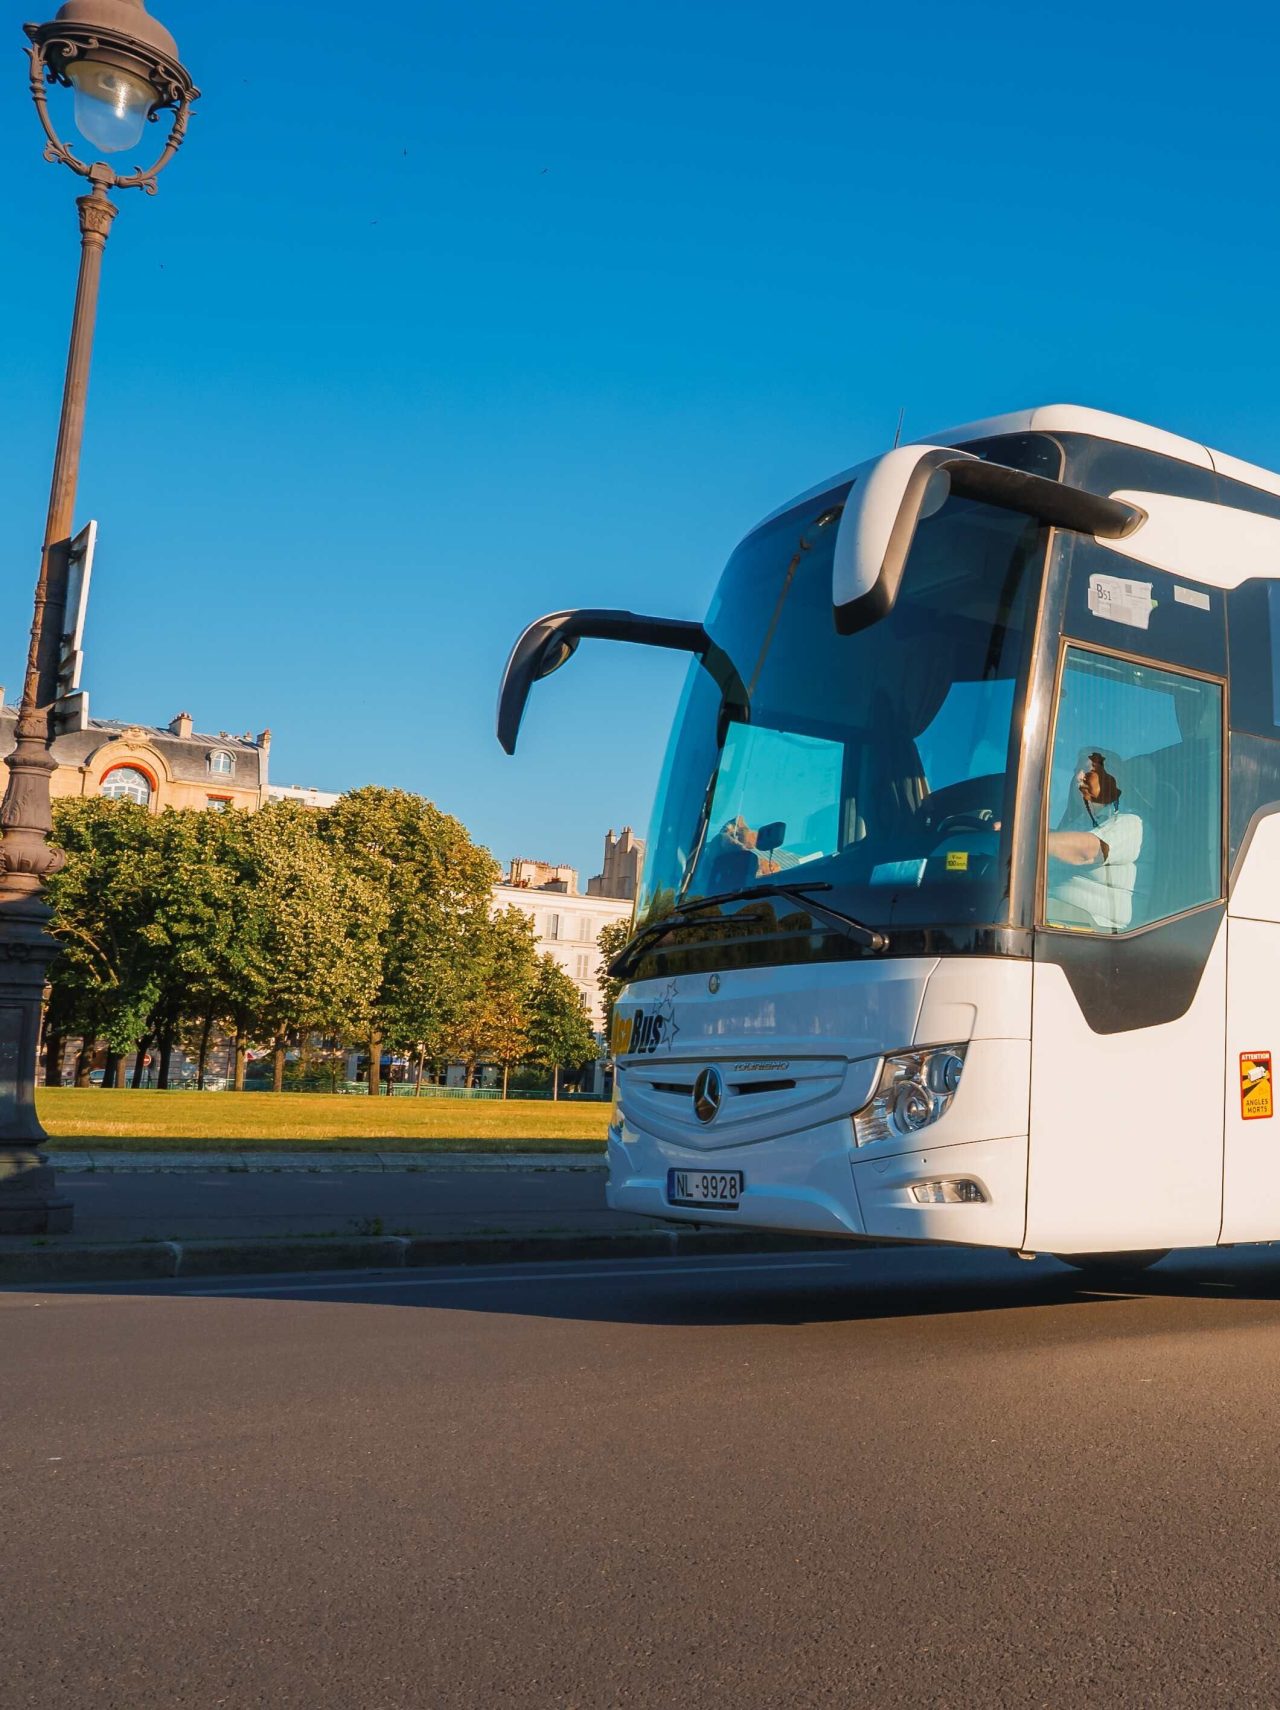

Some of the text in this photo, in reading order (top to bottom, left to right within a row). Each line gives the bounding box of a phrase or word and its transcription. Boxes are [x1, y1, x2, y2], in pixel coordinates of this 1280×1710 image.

[1246, 1098, 1268, 1106] ANGLES
[1248, 1106, 1267, 1114] MORTS
[677, 1173, 737, 1199] NL-9928
